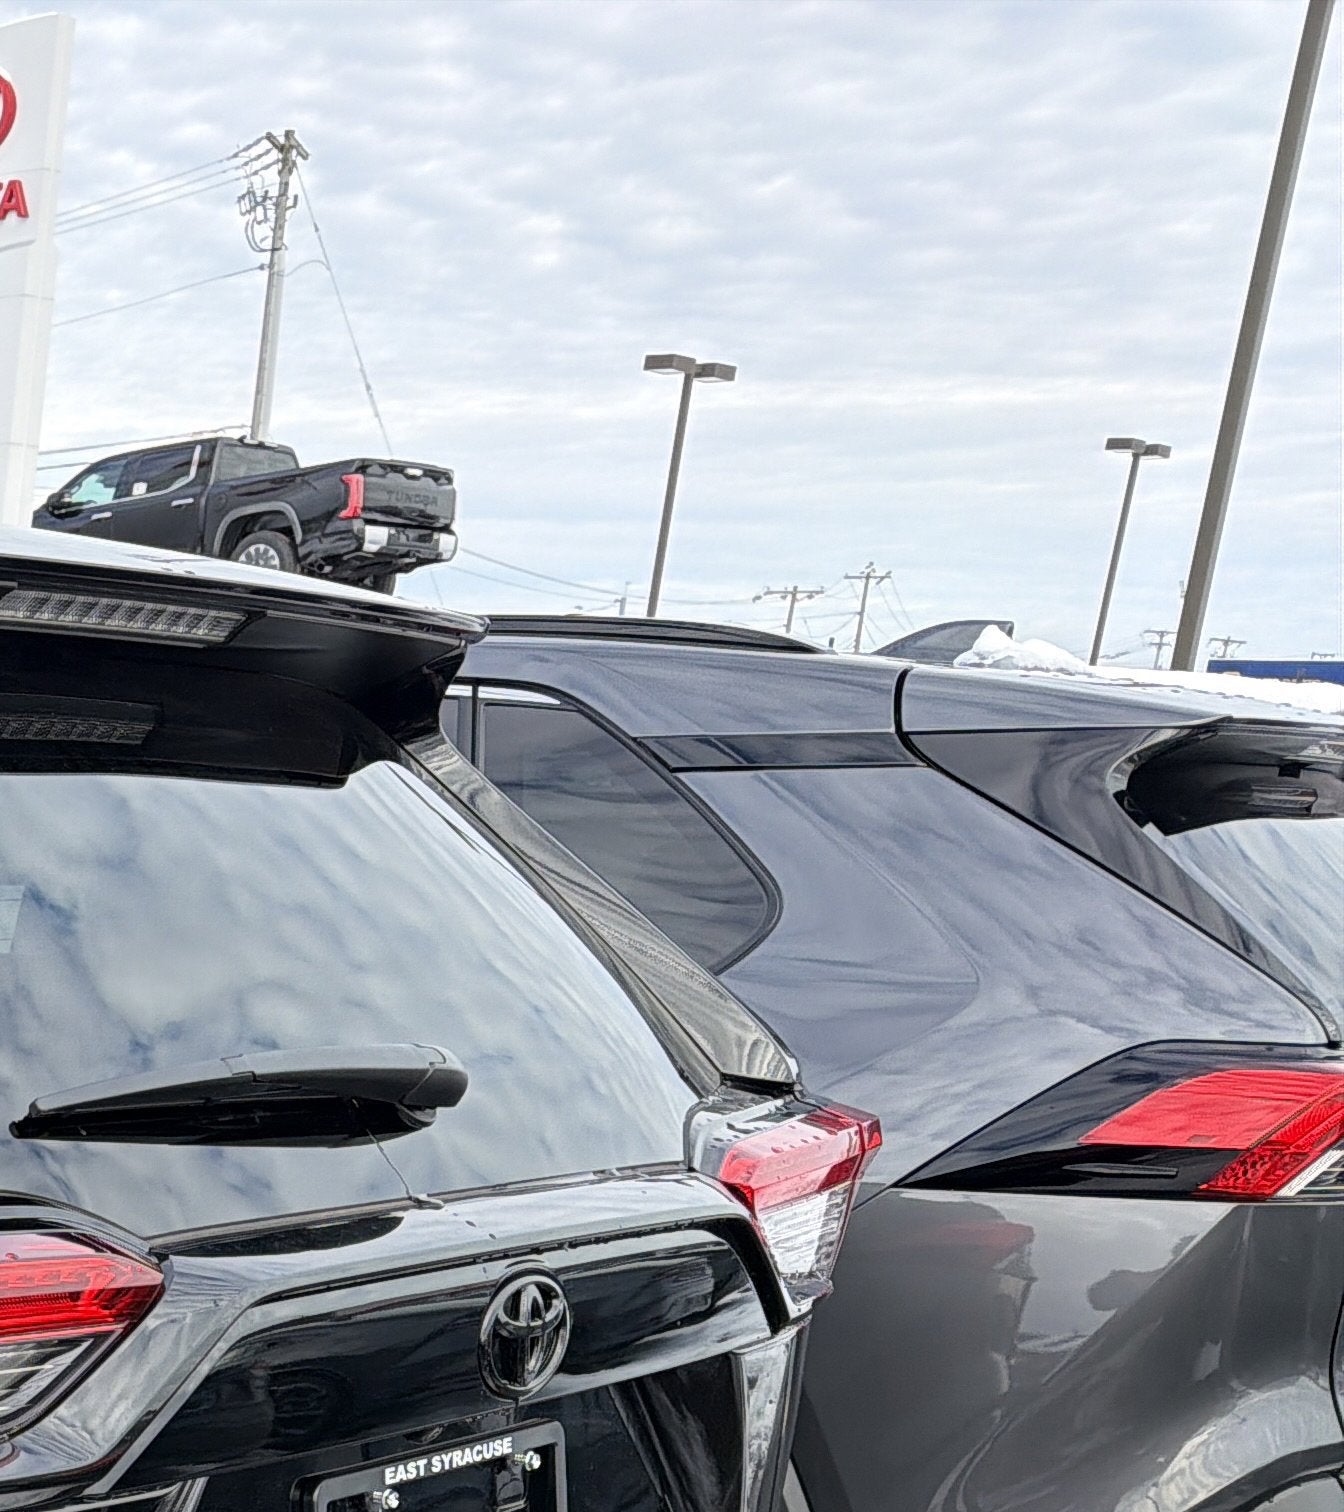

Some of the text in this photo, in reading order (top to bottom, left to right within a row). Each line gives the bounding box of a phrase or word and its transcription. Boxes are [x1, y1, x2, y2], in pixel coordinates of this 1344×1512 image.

[386, 490, 438, 507] TUNDRA
[384, 1436, 513, 1486] EAST SYRACUSE
